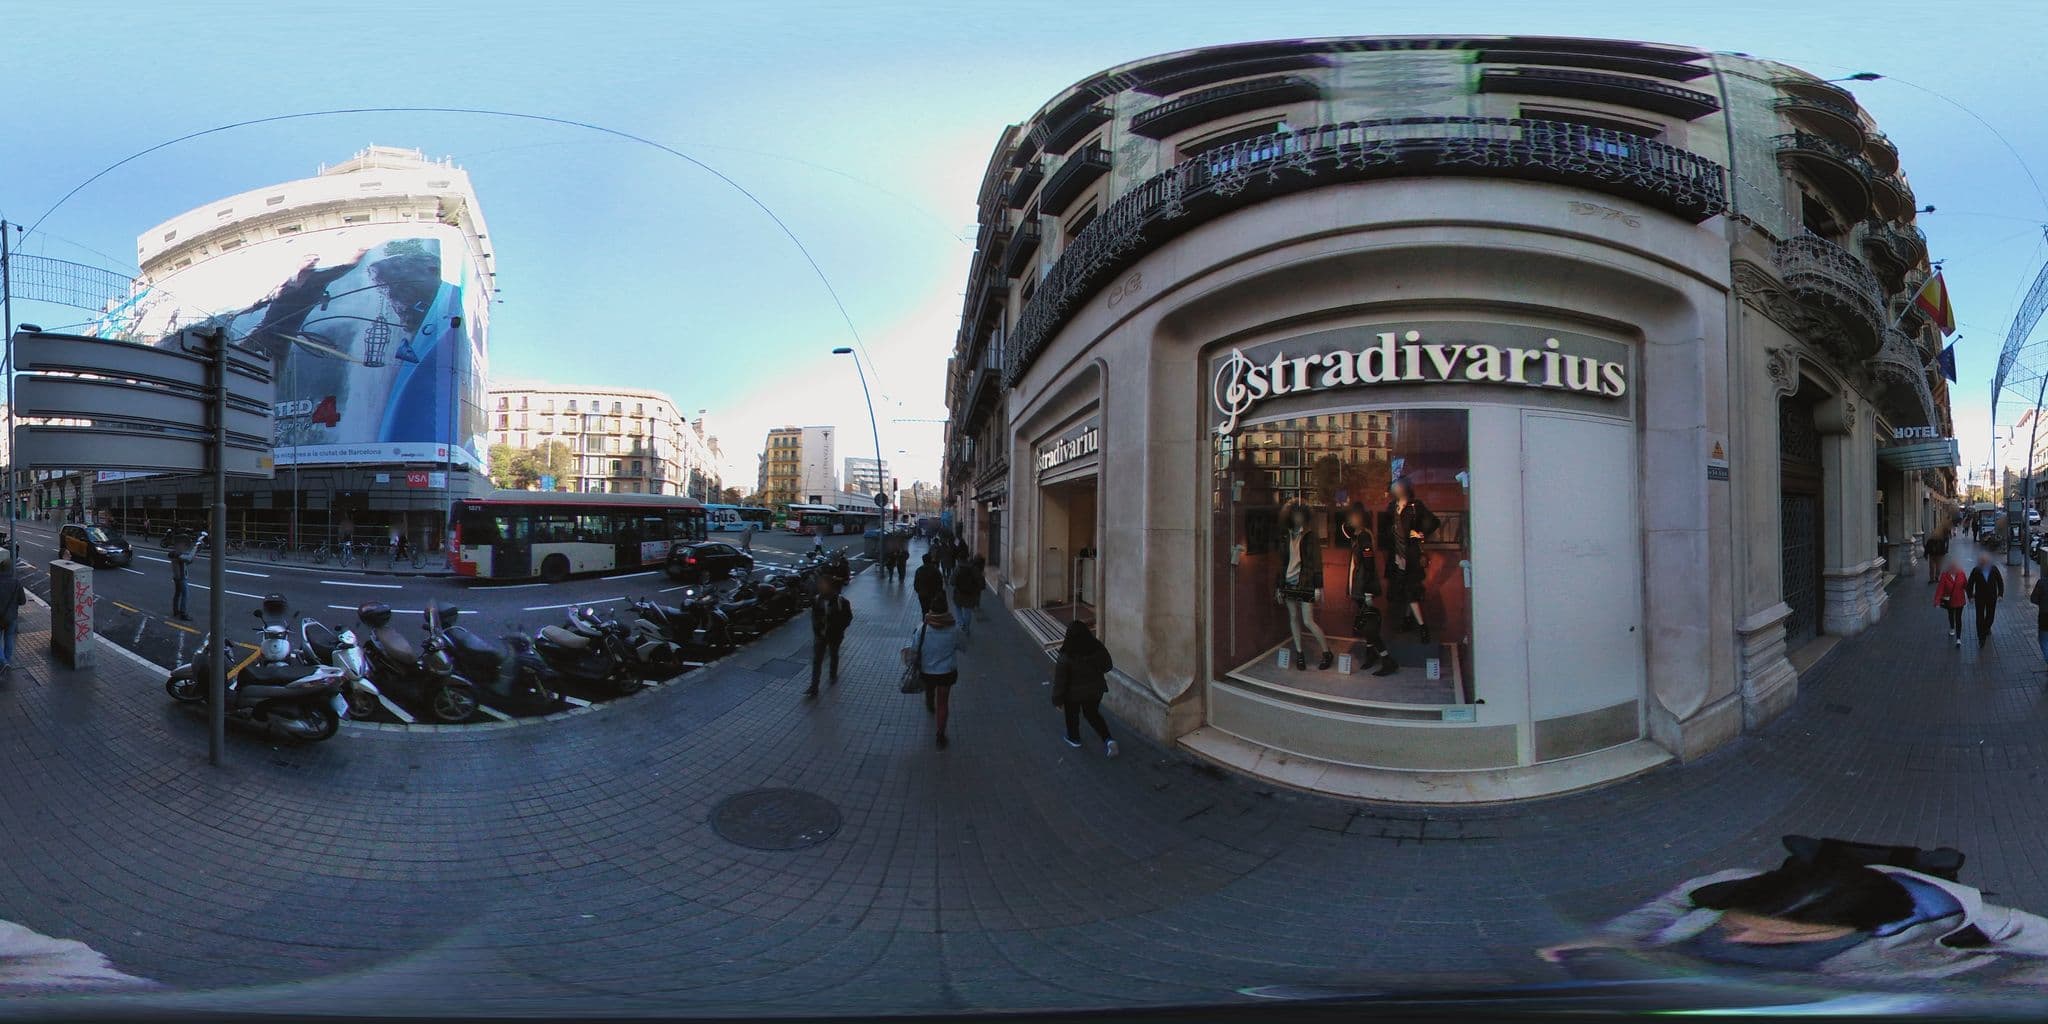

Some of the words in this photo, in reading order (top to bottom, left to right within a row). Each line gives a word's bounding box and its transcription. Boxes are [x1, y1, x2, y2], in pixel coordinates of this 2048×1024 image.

[1243, 329, 1627, 399] stradivarius
[311, 395, 341, 428] 4
[1893, 425, 1940, 439] HOTEL
[348, 446, 382, 456] Barcelona
[1038, 425, 1099, 471] stradivariu
[713, 510, 737, 523] bus
